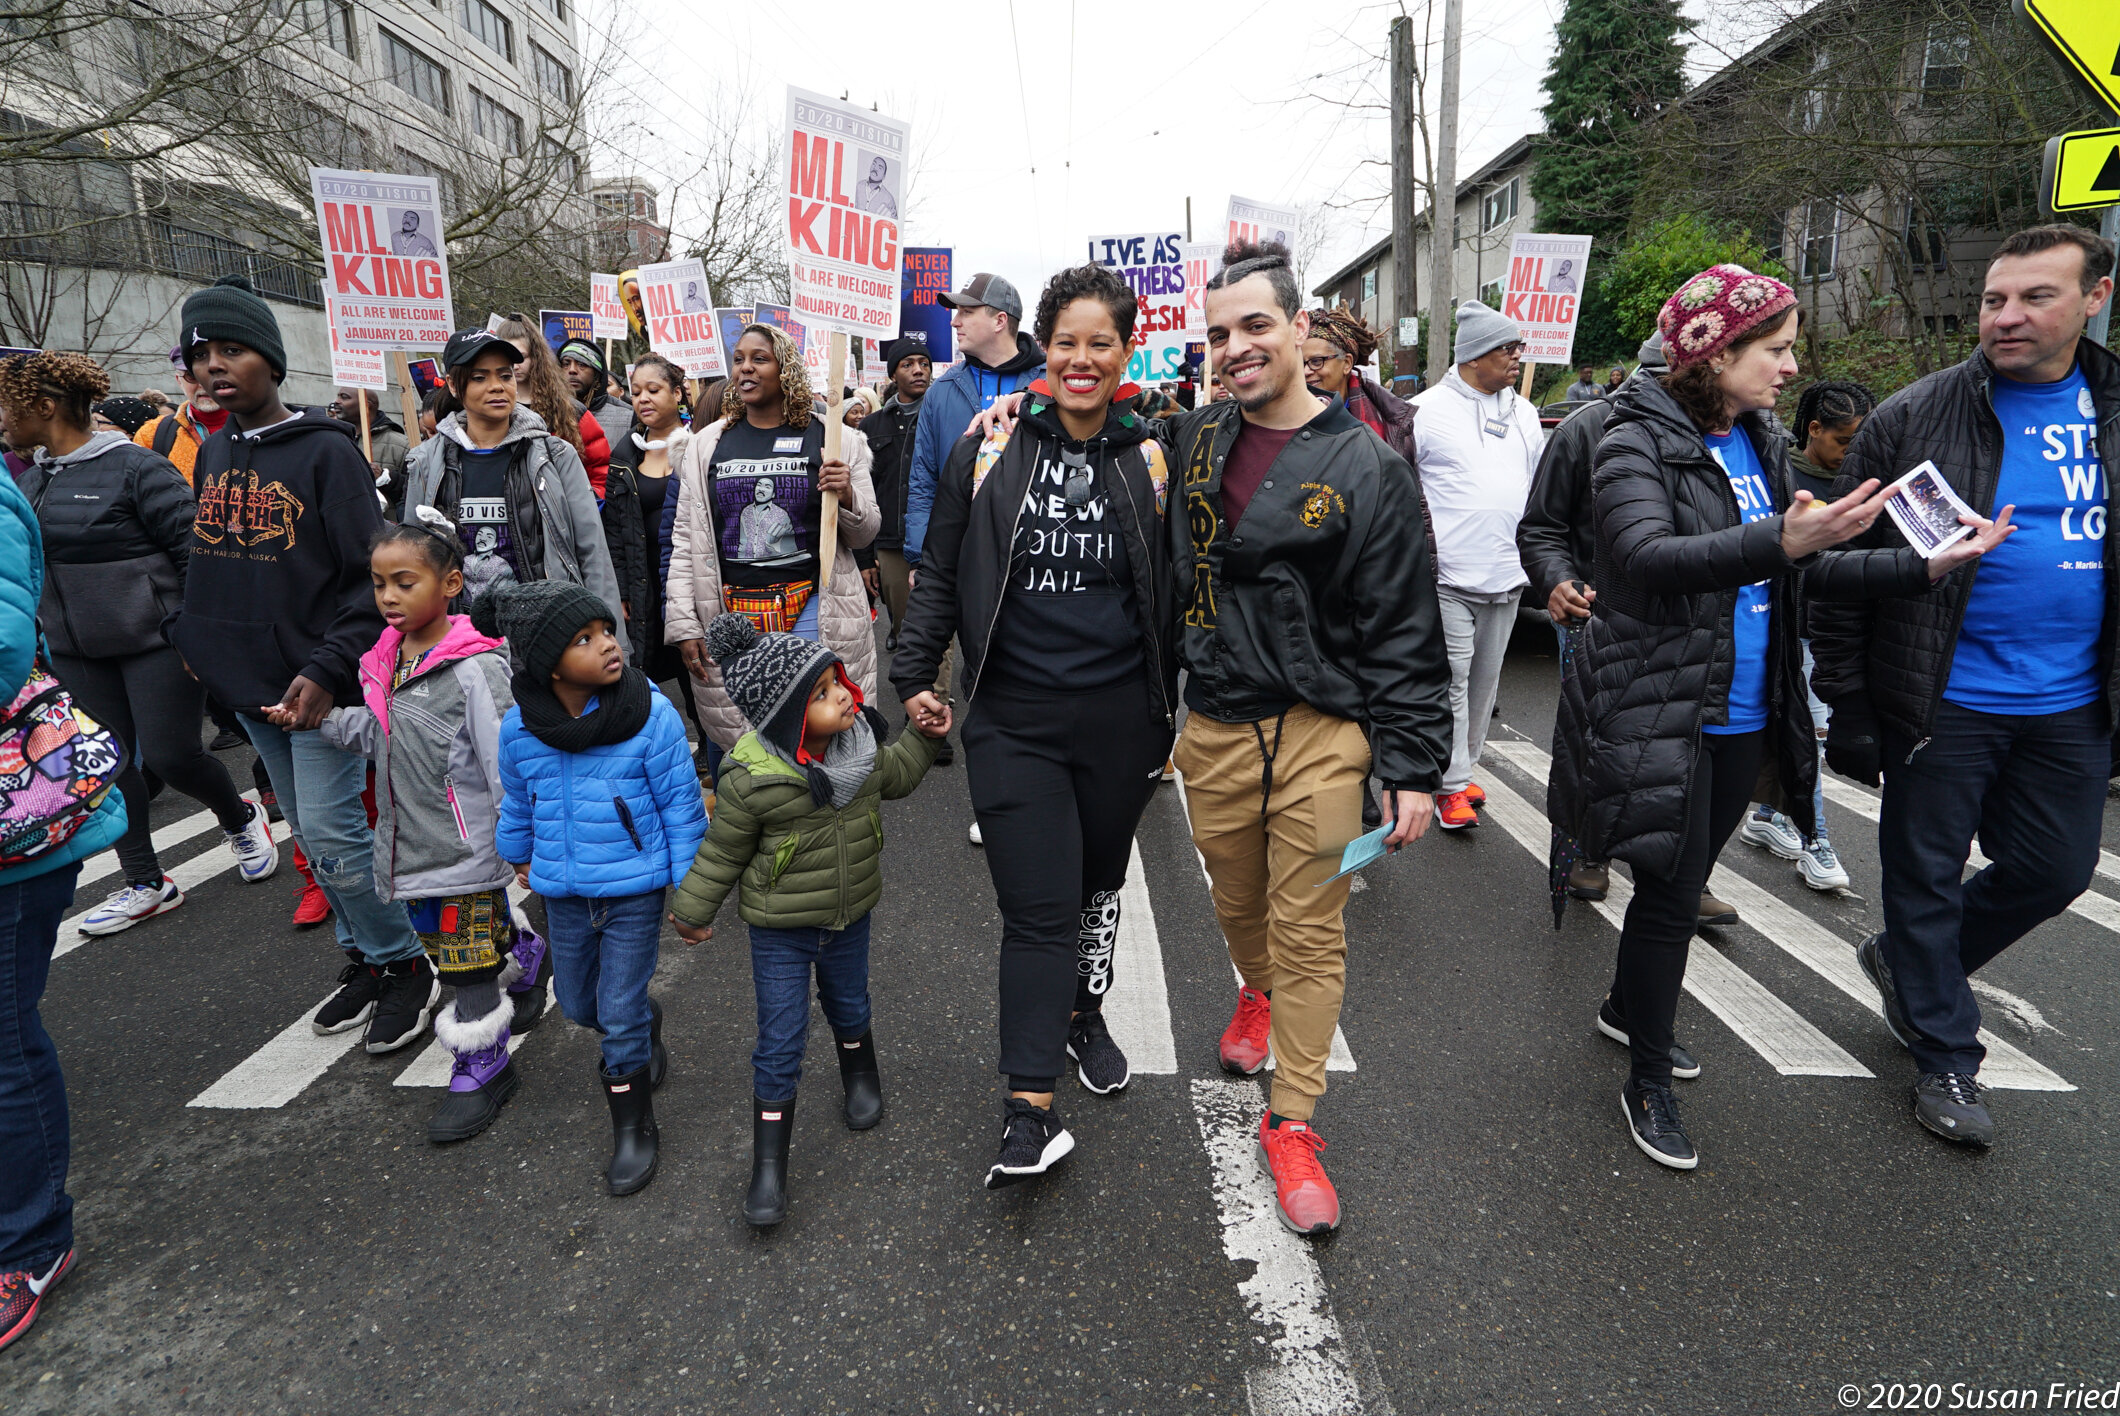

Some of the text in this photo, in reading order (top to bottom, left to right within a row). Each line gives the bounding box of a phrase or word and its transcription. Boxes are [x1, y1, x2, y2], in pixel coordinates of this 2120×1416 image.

[797, 106, 843, 129] 20/20
[851, 122, 899, 149] VISION
[790, 130, 854, 208] M.L.
[323, 182, 429, 201] 20/20 VISION
[323, 202, 393, 256] M.L.
[789, 197, 897, 272] KING
[1089, 234, 1182, 267] LIVE AS
[1517, 242, 1584, 253] 20/20 VISION
[332, 254, 444, 299] KING
[795, 263, 806, 282] ALL
[809, 269, 833, 288] ARE
[837, 274, 893, 300] WELCOME
[916, 272, 949, 288] LOSE
[341, 305, 447, 321] ALL ARE WELCOME
[593, 302, 626, 320] KING
[795, 292, 840, 317] JANUARY
[863, 308, 892, 327] 2020
[1505, 292, 1575, 324] KING
[345, 327, 396, 340] JANUARY
[420, 329, 449, 342] 2020
[567, 330, 592, 341] WITH
[652, 313, 714, 345] KING
[1532, 330, 1569, 340] WELCOME
[670, 350, 684, 359] ARE
[685, 346, 716, 357] WELCOME
[1192, 344, 1206, 354] LOV
[1547, 346, 1567, 355] 2020
[702, 361, 719, 370] 2020
[1127, 347, 1181, 381] OLS
[775, 439, 799, 449] UNITY
[762, 461, 809, 472] VISION
[1040, 459, 1095, 486] NO
[776, 476, 809, 488] LISTEN
[717, 491, 754, 506] LEGACY
[777, 488, 809, 499] PRIDE
[481, 506, 505, 518] VIS
[1021, 493, 1108, 522] NEW
[2060, 505, 2108, 541] LO
[2075, 561, 2098, 570] Martin
[1024, 567, 1087, 593] JAIL
